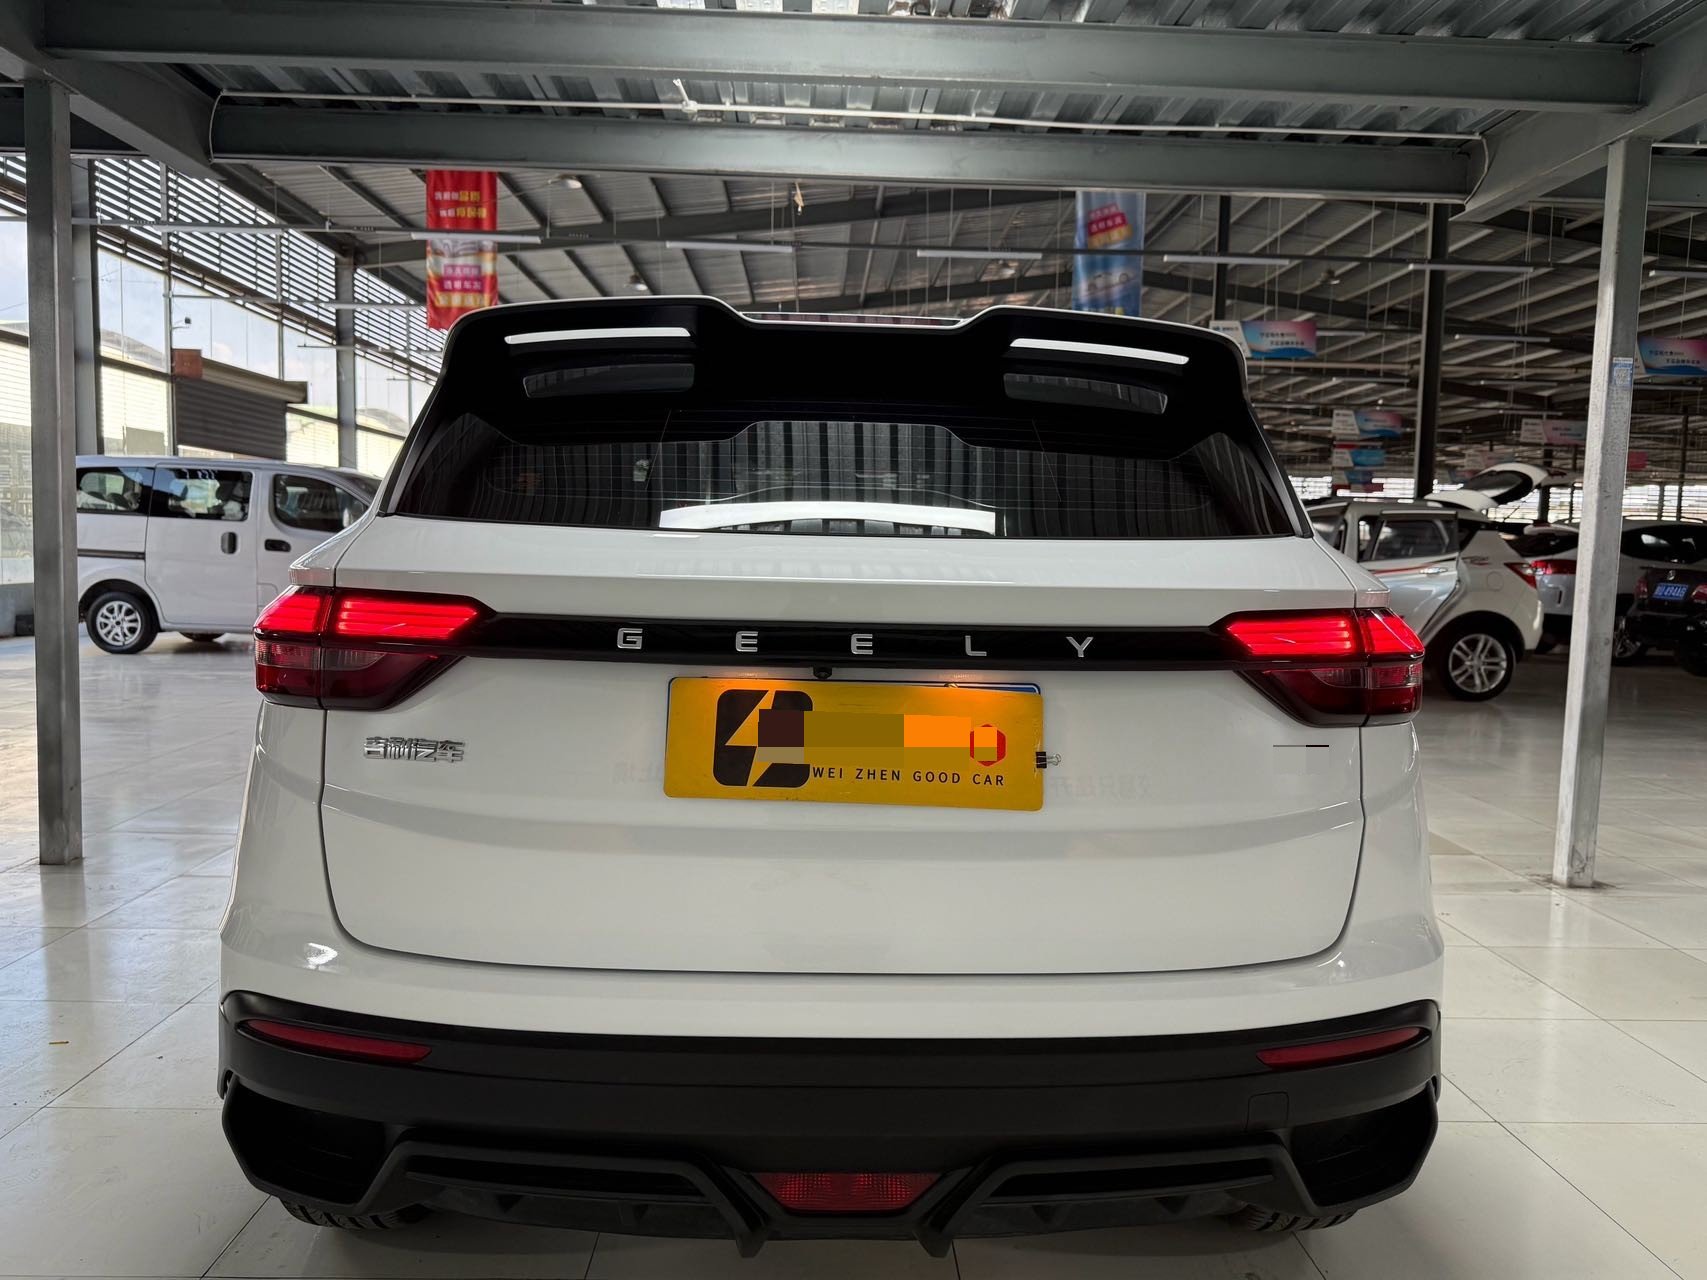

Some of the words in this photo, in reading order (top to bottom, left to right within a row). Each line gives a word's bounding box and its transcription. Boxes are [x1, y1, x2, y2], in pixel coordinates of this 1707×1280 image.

[616, 626, 1095, 659] GEELY
[363, 736, 465, 763] 吉利汽车
[812, 766, 844, 779] WEI
[855, 768, 901, 781] ZHEN
[912, 770, 961, 784] GOOD
[972, 773, 1005, 786] CAR
